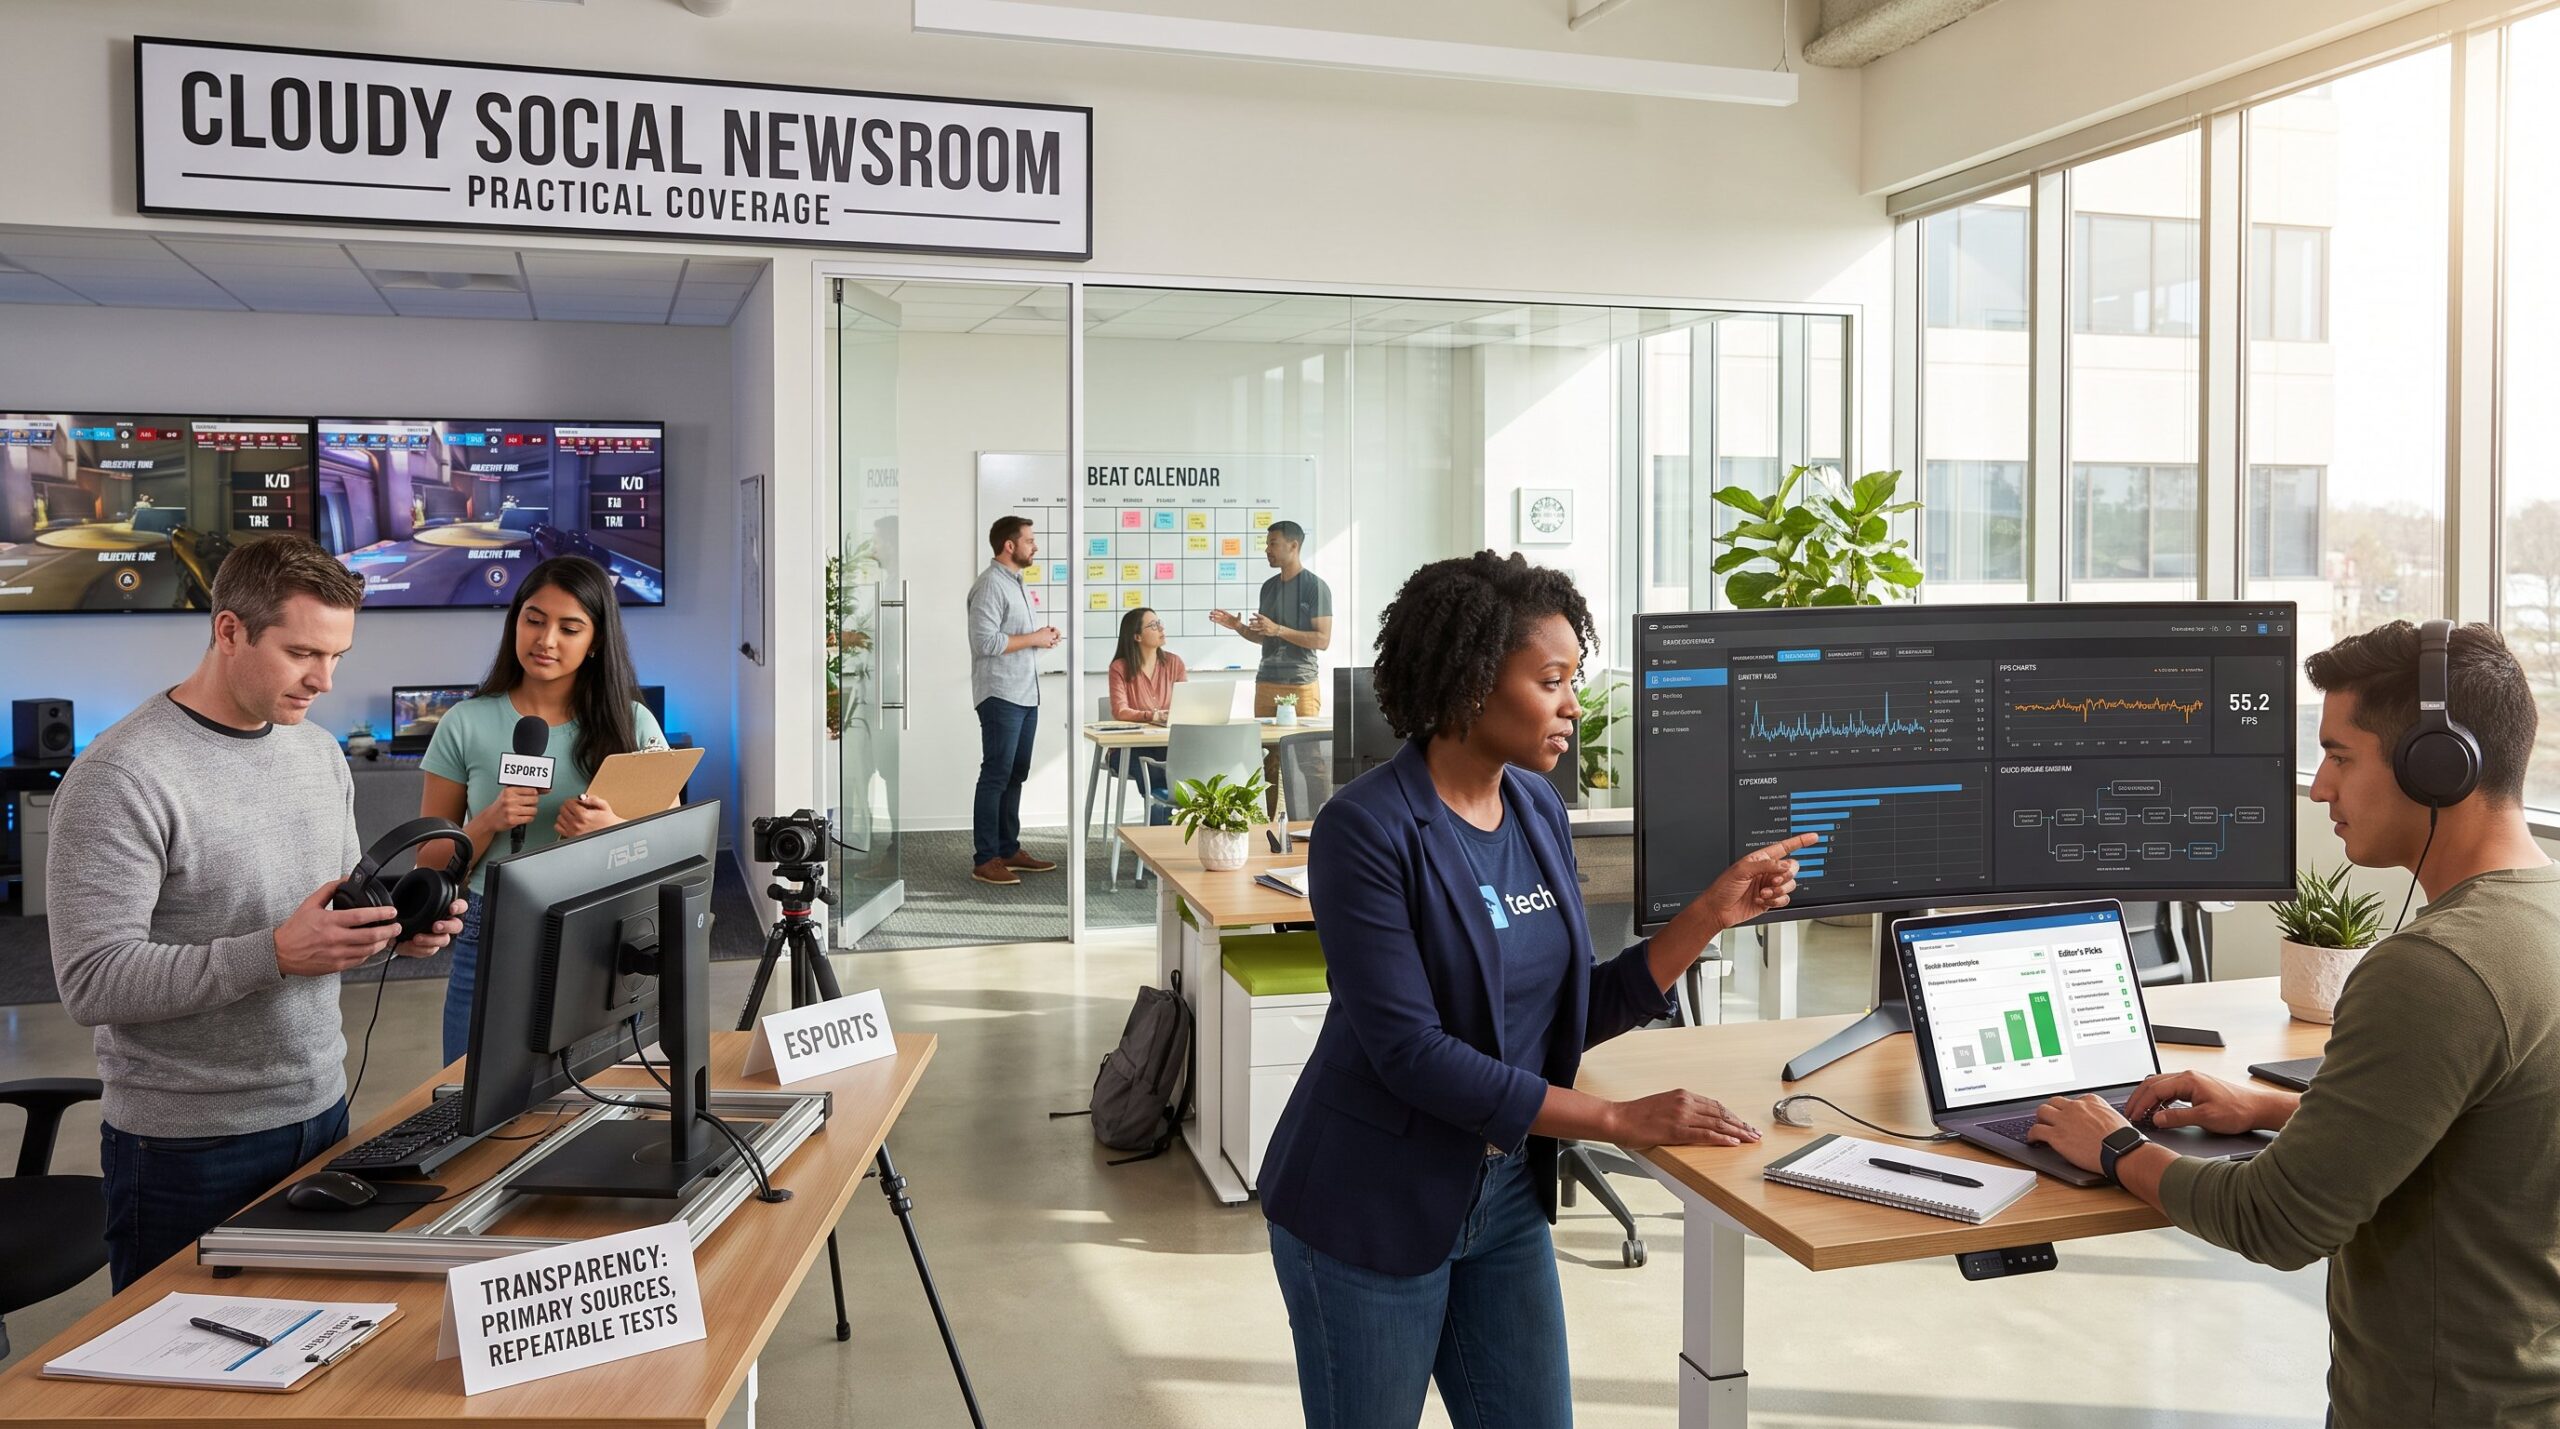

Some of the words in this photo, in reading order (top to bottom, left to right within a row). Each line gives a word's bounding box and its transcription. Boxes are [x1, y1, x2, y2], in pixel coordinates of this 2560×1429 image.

[181, 70, 452, 159] CLOUDY
[475, 91, 702, 175] SOCIAL
[724, 109, 1060, 195] NEWSROOM
[468, 175, 652, 217] PRACTICAL
[666, 186, 830, 225] COVERAGE
[265, 473, 290, 488] K/D
[621, 476, 644, 490] K/D
[1087, 466, 1129, 486] BEAT
[1134, 466, 1220, 487] CALENDAR
[2229, 693, 2270, 711] 55.2
[2241, 716, 2258, 725] FPS
[504, 763, 549, 778] ESPORTS
[606, 839, 649, 870] ASUS
[1504, 883, 1557, 915] tech
[2058, 948, 2084, 957] Editor's
[2084, 946, 2103, 955] Picks
[783, 1012, 878, 1060] ESPORTS
[480, 1244, 668, 1305] TRANSPARENCY:
[481, 1296, 574, 1337] PRIMARY
[581, 1275, 676, 1314] SOURCES,
[489, 1317, 615, 1367] REPEATABLE
[619, 1303, 678, 1336] TESTS
